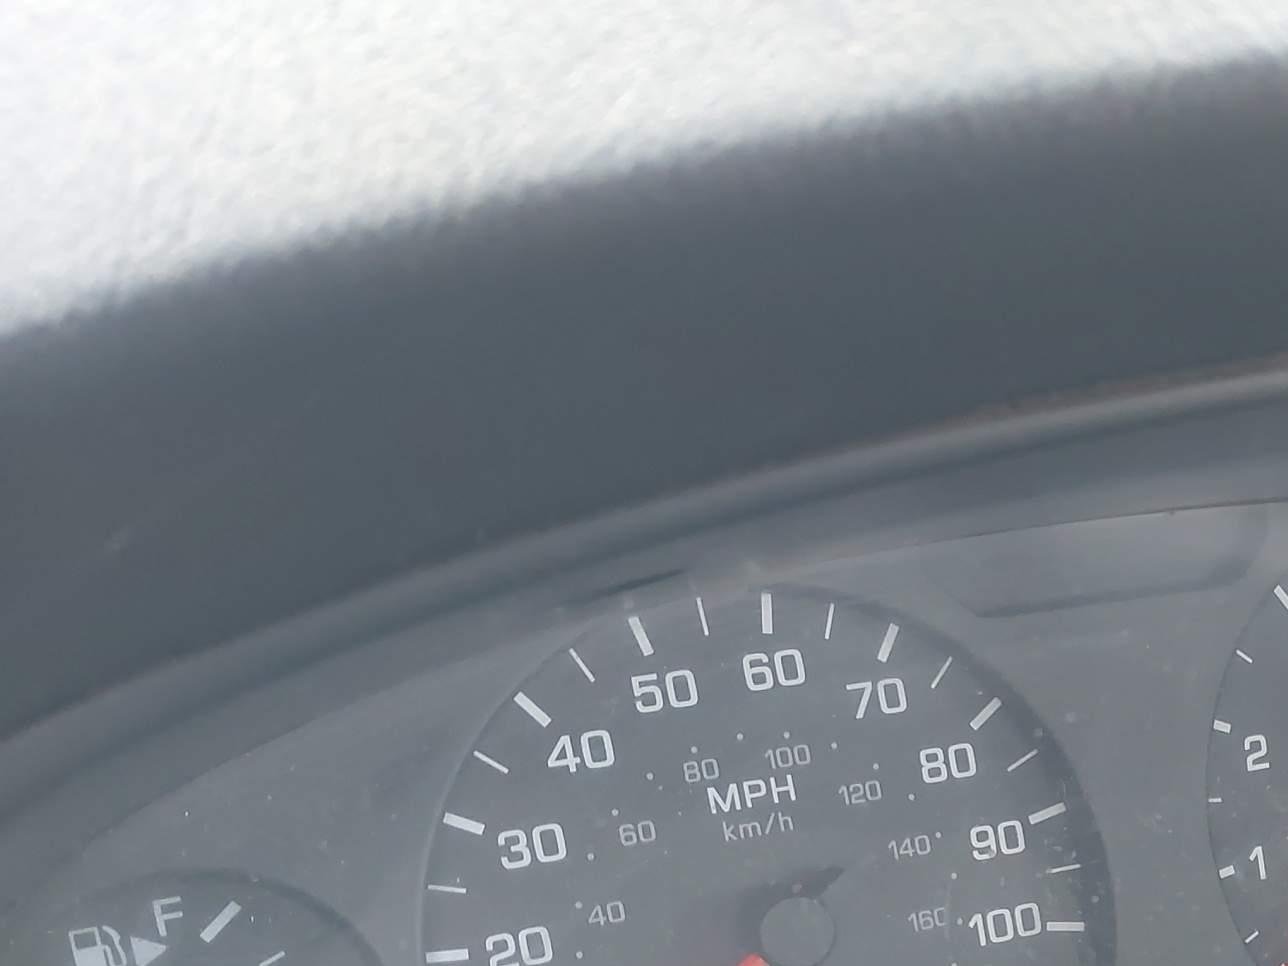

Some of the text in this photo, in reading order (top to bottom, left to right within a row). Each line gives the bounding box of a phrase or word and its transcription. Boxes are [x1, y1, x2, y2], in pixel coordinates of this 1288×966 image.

[742, 648, 806, 691] 60
[631, 669, 699, 713] 50
[846, 678, 908, 719] 70
[547, 730, 615, 773] 40
[683, 758, 719, 783] 80
[764, 744, 811, 769] 100
[919, 743, 977, 783] 80
[1244, 734, 1270, 772] 2
[707, 774, 797, 814] MPH
[838, 780, 882, 806] 120
[497, 823, 567, 869] 30
[618, 820, 656, 846] 60
[722, 811, 794, 842] km/h
[969, 820, 1026, 861] 90
[888, 834, 931, 860] 140
[1249, 845, 1268, 880] 1
[152, 896, 184, 936] F
[588, 901, 626, 925] 40
[908, 907, 946, 932] 160
[968, 902, 1042, 946] 100
